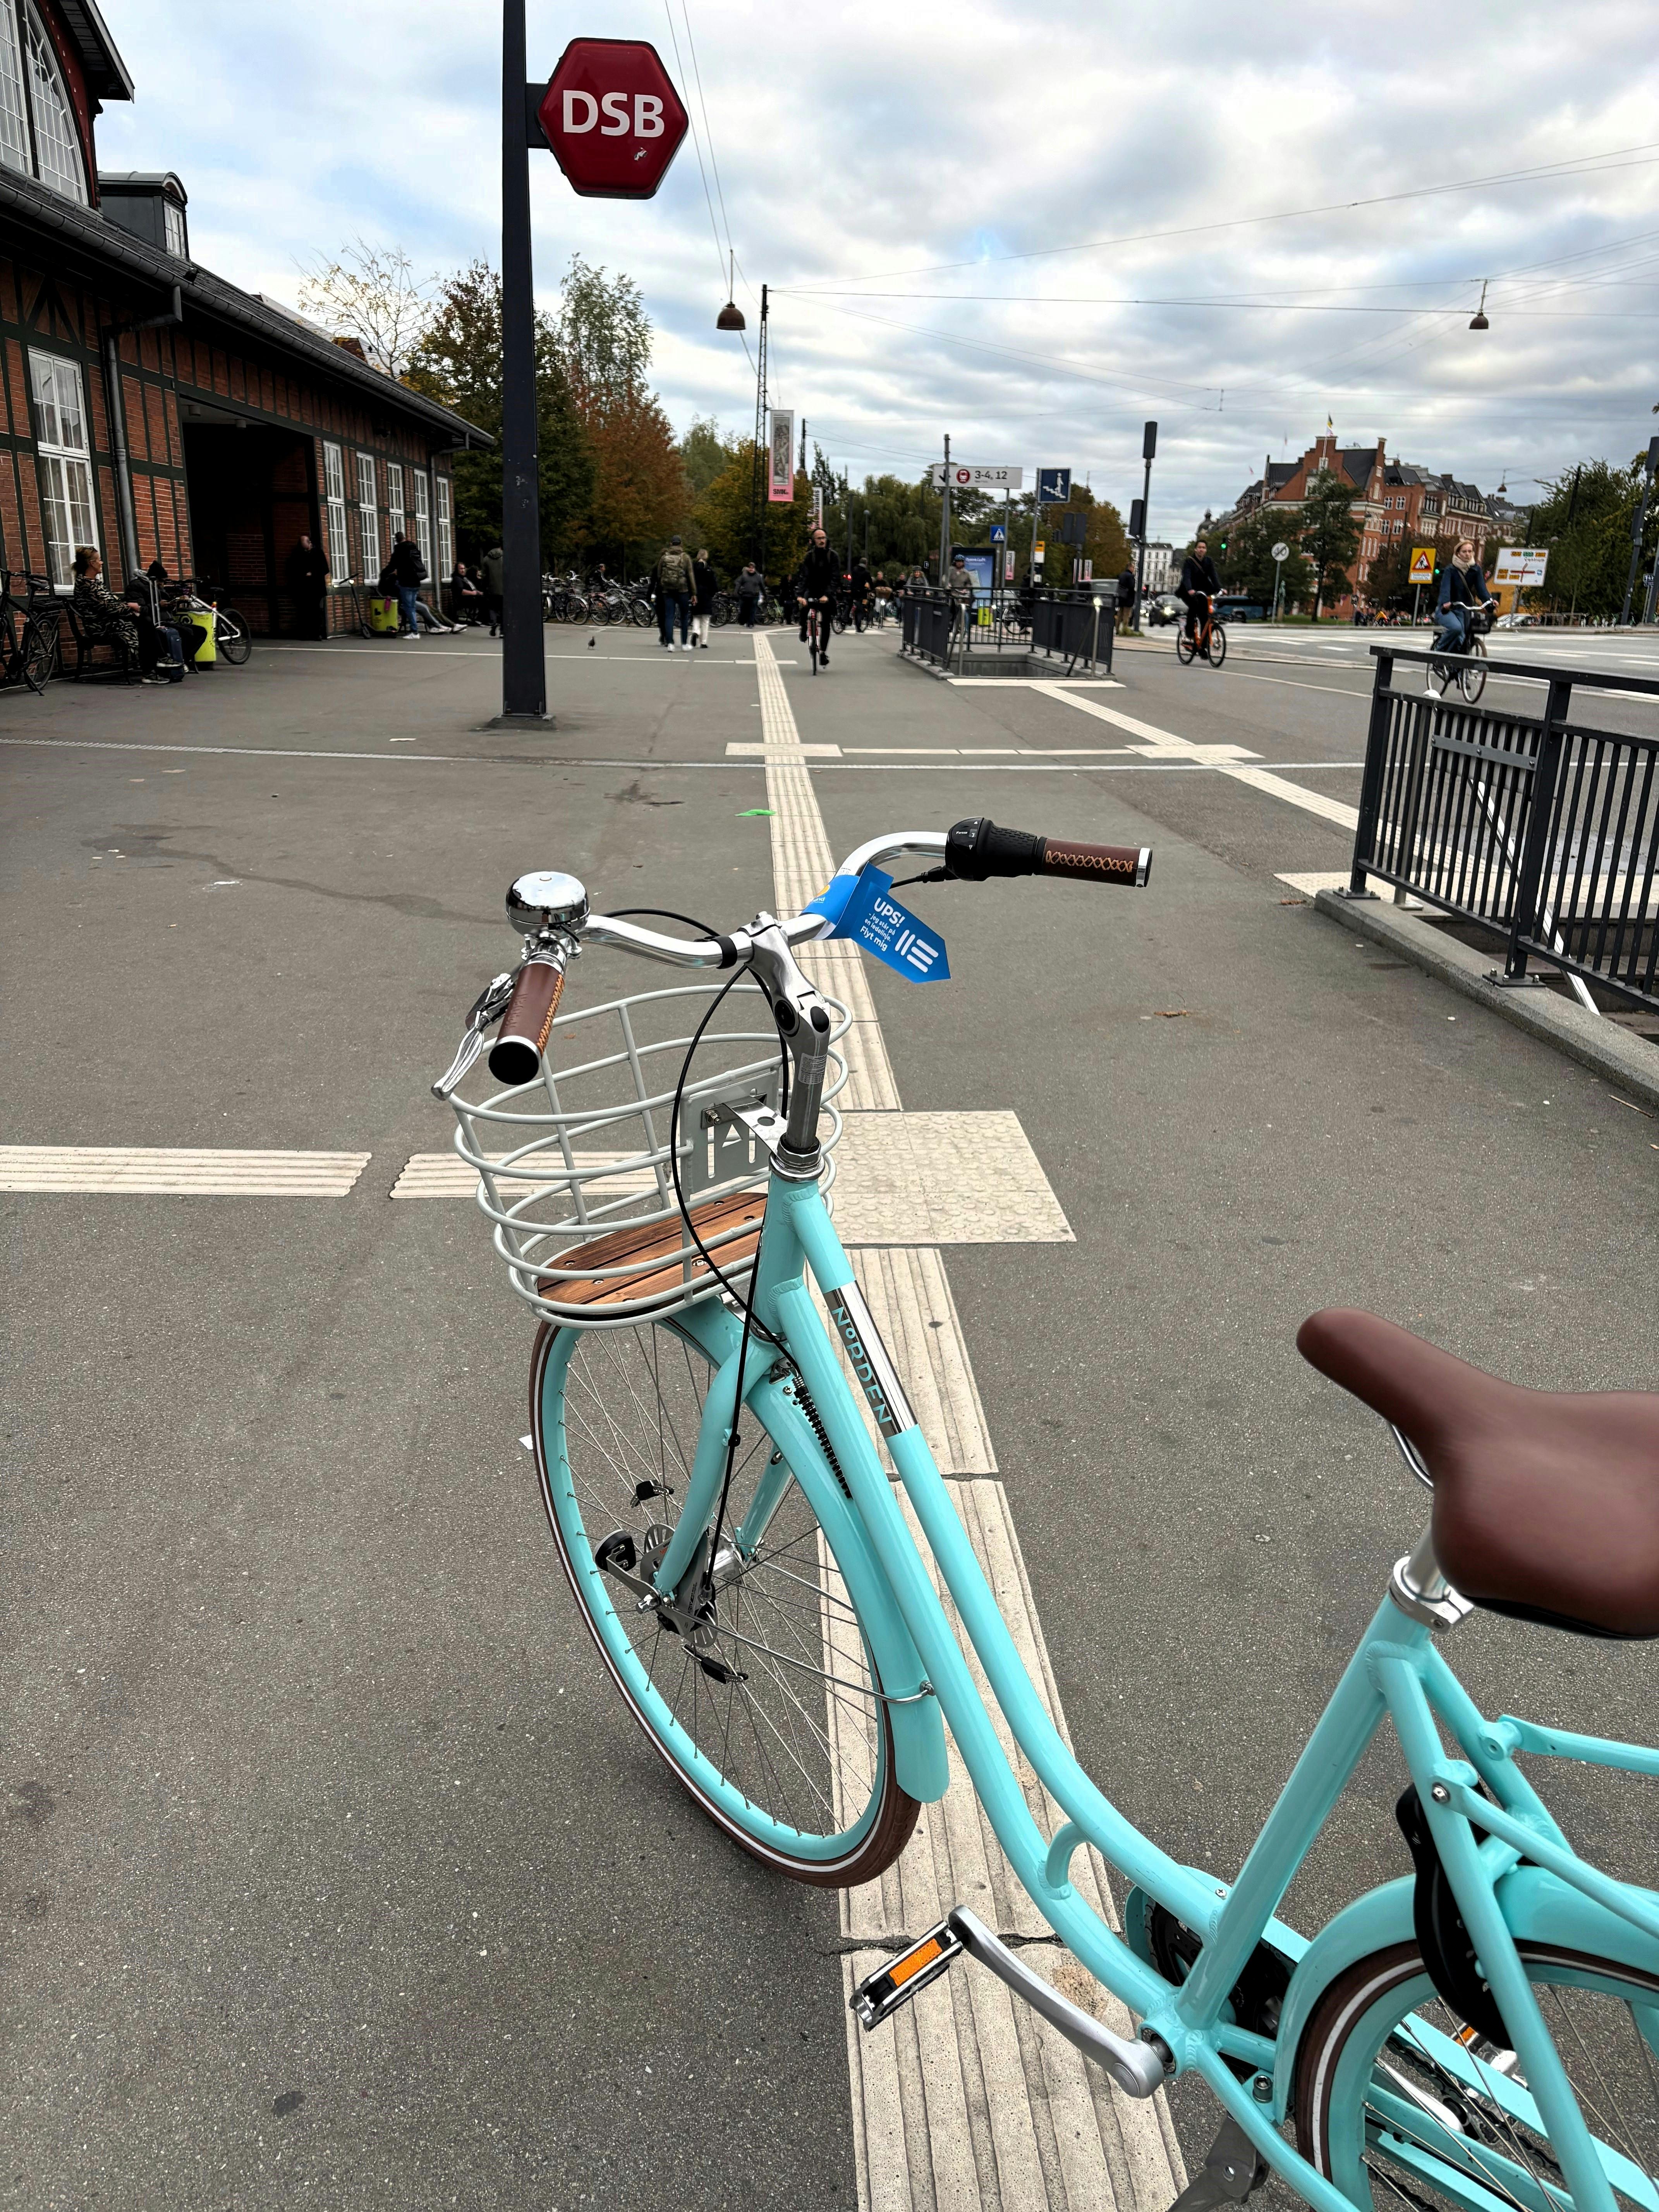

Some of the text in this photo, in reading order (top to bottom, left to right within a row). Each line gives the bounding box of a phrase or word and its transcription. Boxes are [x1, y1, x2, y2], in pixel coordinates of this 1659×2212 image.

[563, 90, 665, 138] DSB
[995, 471, 1008, 480] 12
[874, 897, 905, 927] UPS!
[860, 925, 888, 951] Flyt mig
[879, 921, 889, 930] står
